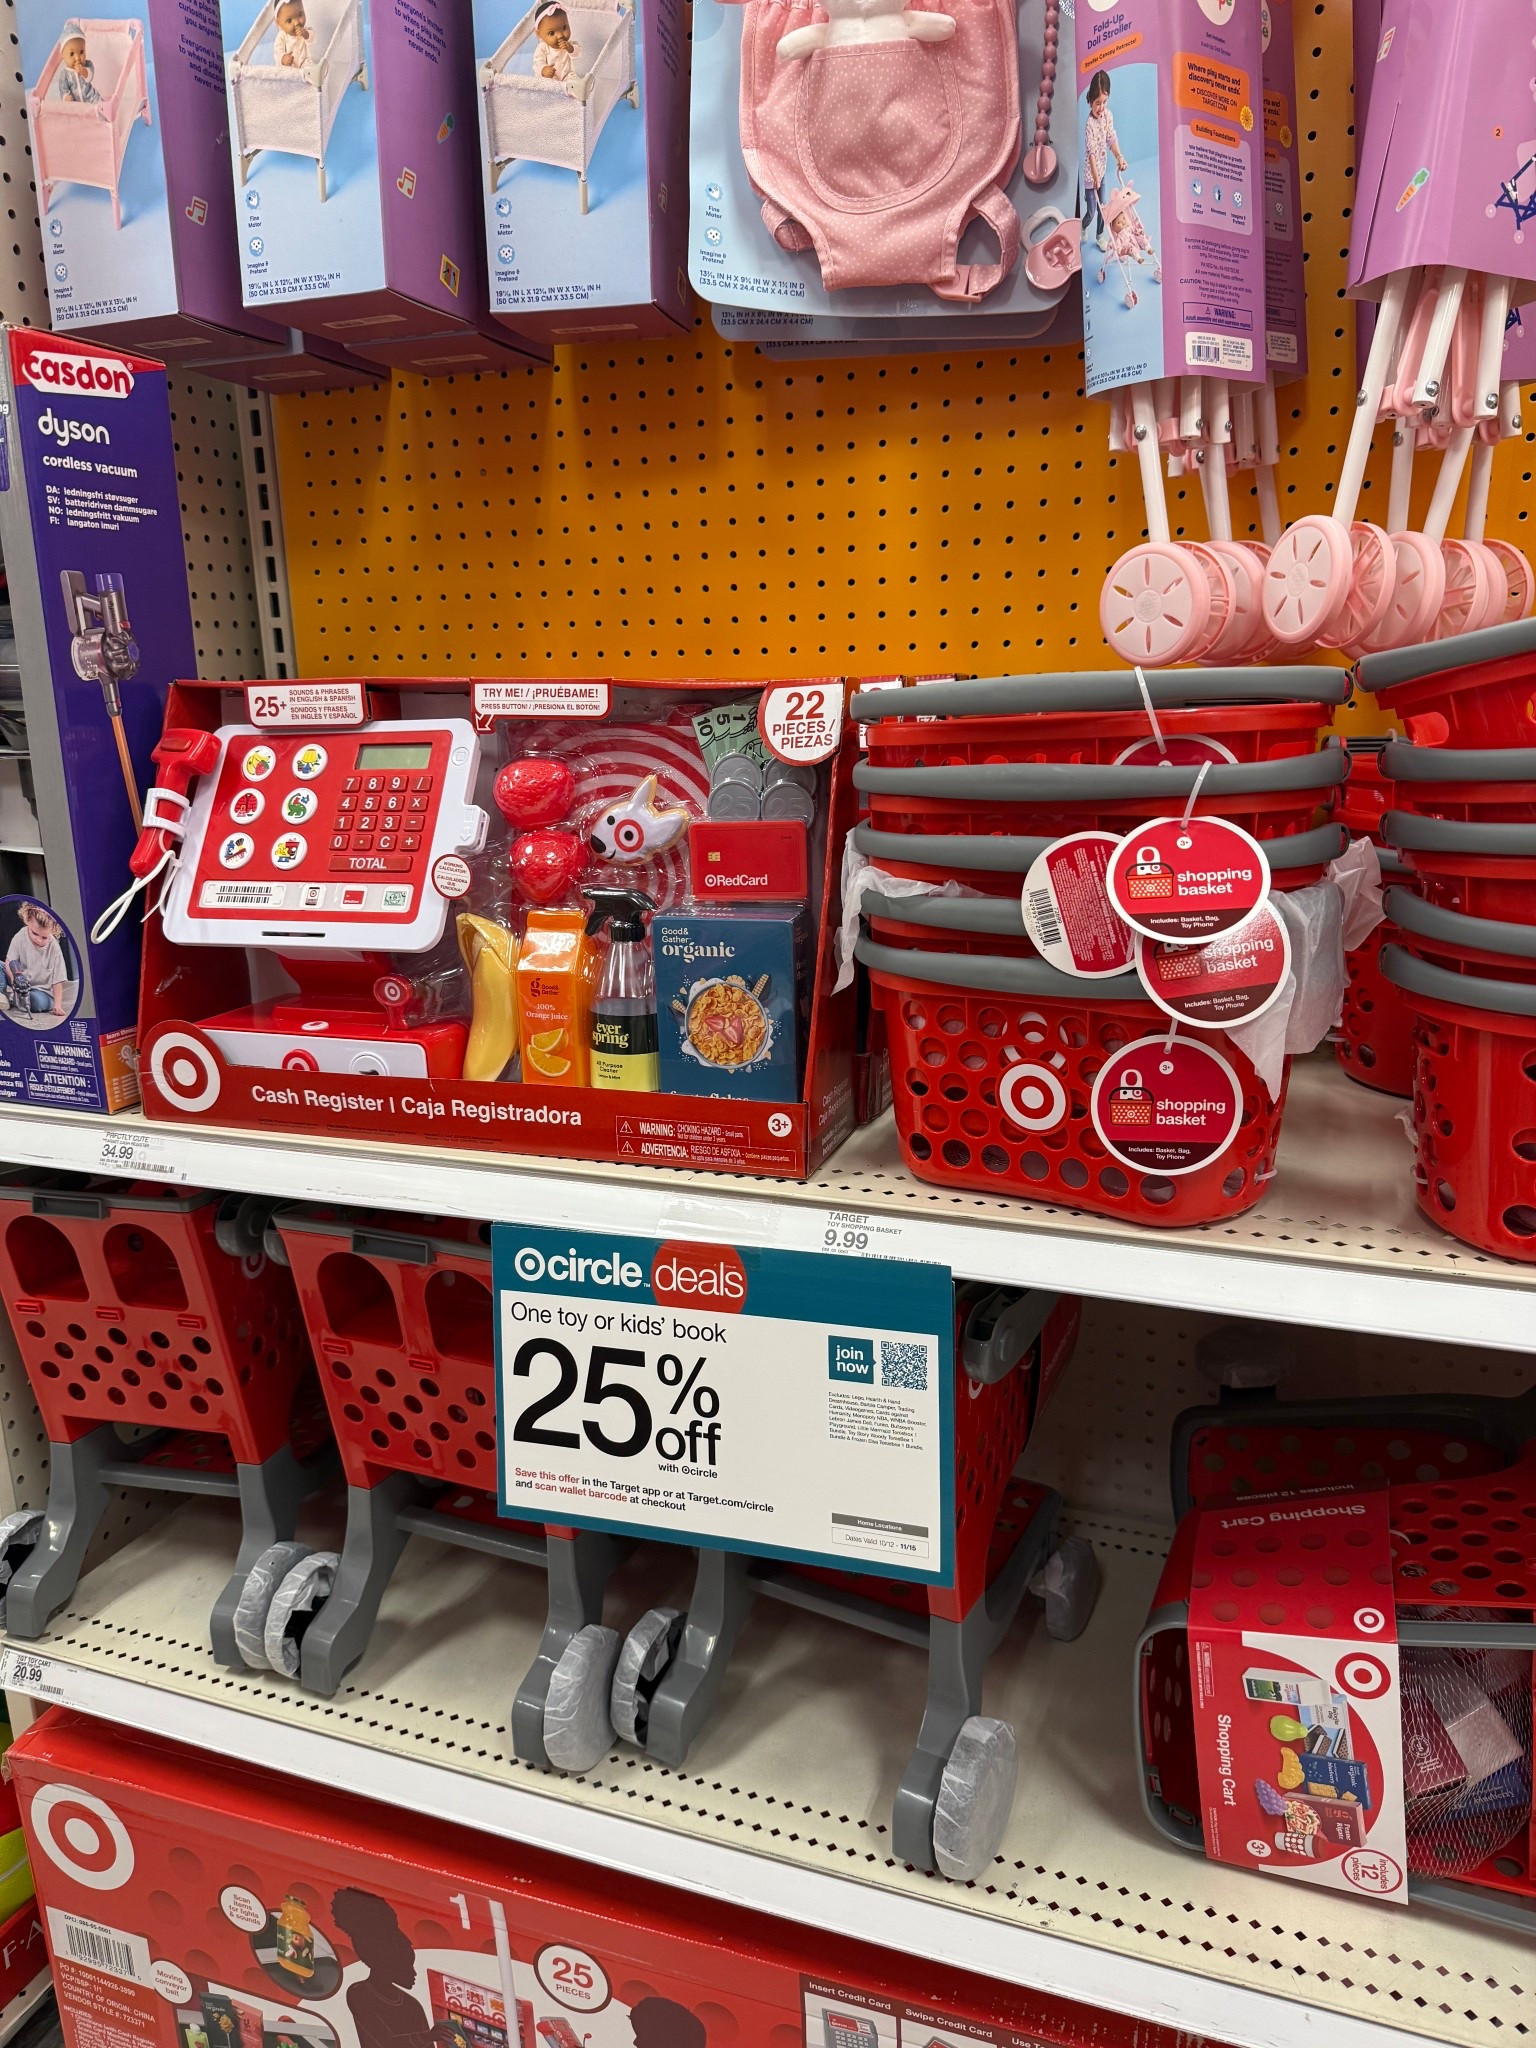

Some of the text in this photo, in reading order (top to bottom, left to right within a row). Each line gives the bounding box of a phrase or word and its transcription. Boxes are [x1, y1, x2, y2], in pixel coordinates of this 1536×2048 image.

[1093, 14, 1124, 35] Fold-Up
[1087, 21, 1132, 50] Doll Stroller
[1187, 62, 1218, 79] Where play
[1196, 88, 1218, 100] DISCOVER
[1196, 124, 1236, 143] Building Foundations
[699, 277, 717, 287] (33.5
[740, 283, 755, 292] 24.4
[25, 354, 132, 394] casdon
[38, 408, 110, 446] dyson
[42, 455, 138, 478] cordless vacuum
[46, 485, 60, 494] DA:
[47, 496, 60, 504] SV:
[483, 688, 523, 698] TRY ME!
[290, 706, 318, 714] SONIDOS
[786, 690, 824, 721] 22
[772, 720, 826, 736] PIECES
[780, 734, 833, 750] PIEZAS
[346, 777, 400, 790] 7 8 9
[342, 797, 397, 809] 4 5 6
[338, 818, 393, 829] 1 2 3
[380, 836, 390, 848] C
[349, 858, 387, 869] TOTAL
[716, 874, 768, 886] RedCard
[1177, 868, 1252, 882] shopping
[1178, 882, 1233, 896] basket
[661, 935, 689, 943] Gather
[662, 941, 736, 963] organic
[1204, 938, 1274, 958] shopping
[1206, 955, 1258, 974] basket
[536, 1003, 556, 1011] 100%
[526, 1011, 568, 1021] Orange Juice
[596, 1022, 622, 1033] ever
[592, 1030, 629, 1049] spring
[53, 1044, 91, 1058] WARNING:
[600, 1066, 618, 1074] Cleaner
[252, 1085, 582, 1126] Cash Register Caja Registradora
[1156, 1098, 1226, 1114] shopping
[771, 1118, 788, 1132] 3+
[1156, 1113, 1206, 1126] basket
[106, 1132, 132, 1140] PRFCTLY
[639, 1122, 722, 1137] WARNING: CHOKING HAZARD
[101, 1144, 134, 1159] 34.99
[641, 1142, 711, 1158] ADVERTENCIA: RIESGO
[828, 1211, 870, 1224] TARGET
[840, 1222, 875, 1232] SHOPPING
[876, 1226, 902, 1235] BASKET
[824, 1229, 868, 1250] 9.99
[547, 1247, 744, 1298] circle deals
[511, 1301, 727, 1343] One toy or kids’ book
[836, 1345, 864, 1360] join
[836, 1361, 869, 1374] now
[655, 1419, 722, 1466] off
[658, 1463, 718, 1479] with circle
[515, 1467, 774, 1513] Save this offer in the Target app or at Target.com/circle
[515, 1479, 686, 1512] and scan wallet barcode at checkout
[1220, 1505, 1366, 1528] Shopping Cart
[857, 1519, 902, 1531] Home Locations
[846, 1534, 916, 1551] Dates 10/12 11/15
[13, 1664, 42, 1682] 20.99
[1216, 1714, 1236, 1806] Shopping Cart
[1336, 1822, 1344, 1840] Rigate
[1252, 1841, 1265, 1856] 3+
[1350, 1856, 1361, 1881] pieces
[1361, 1864, 1379, 1880] 12
[1379, 1858, 1390, 1890] includes
[233, 1893, 251, 1905] Scan
[233, 1900, 252, 1911] items
[64, 1914, 78, 1924] DPCI:
[236, 1914, 261, 1926] sounds
[156, 1969, 183, 1984] Moving
[552, 1956, 594, 1989] 25
[154, 1977, 187, 1991] conveyor
[556, 1984, 591, 2000] PIECES
[62, 1982, 156, 2023] COUNTRY ORIGIN: CHINA
[808, 1981, 892, 2010] Insert Credit Card
[63, 1991, 146, 2028] VENDOR STYLE 723371
[905, 2008, 993, 2039] Swipe Credit Card
